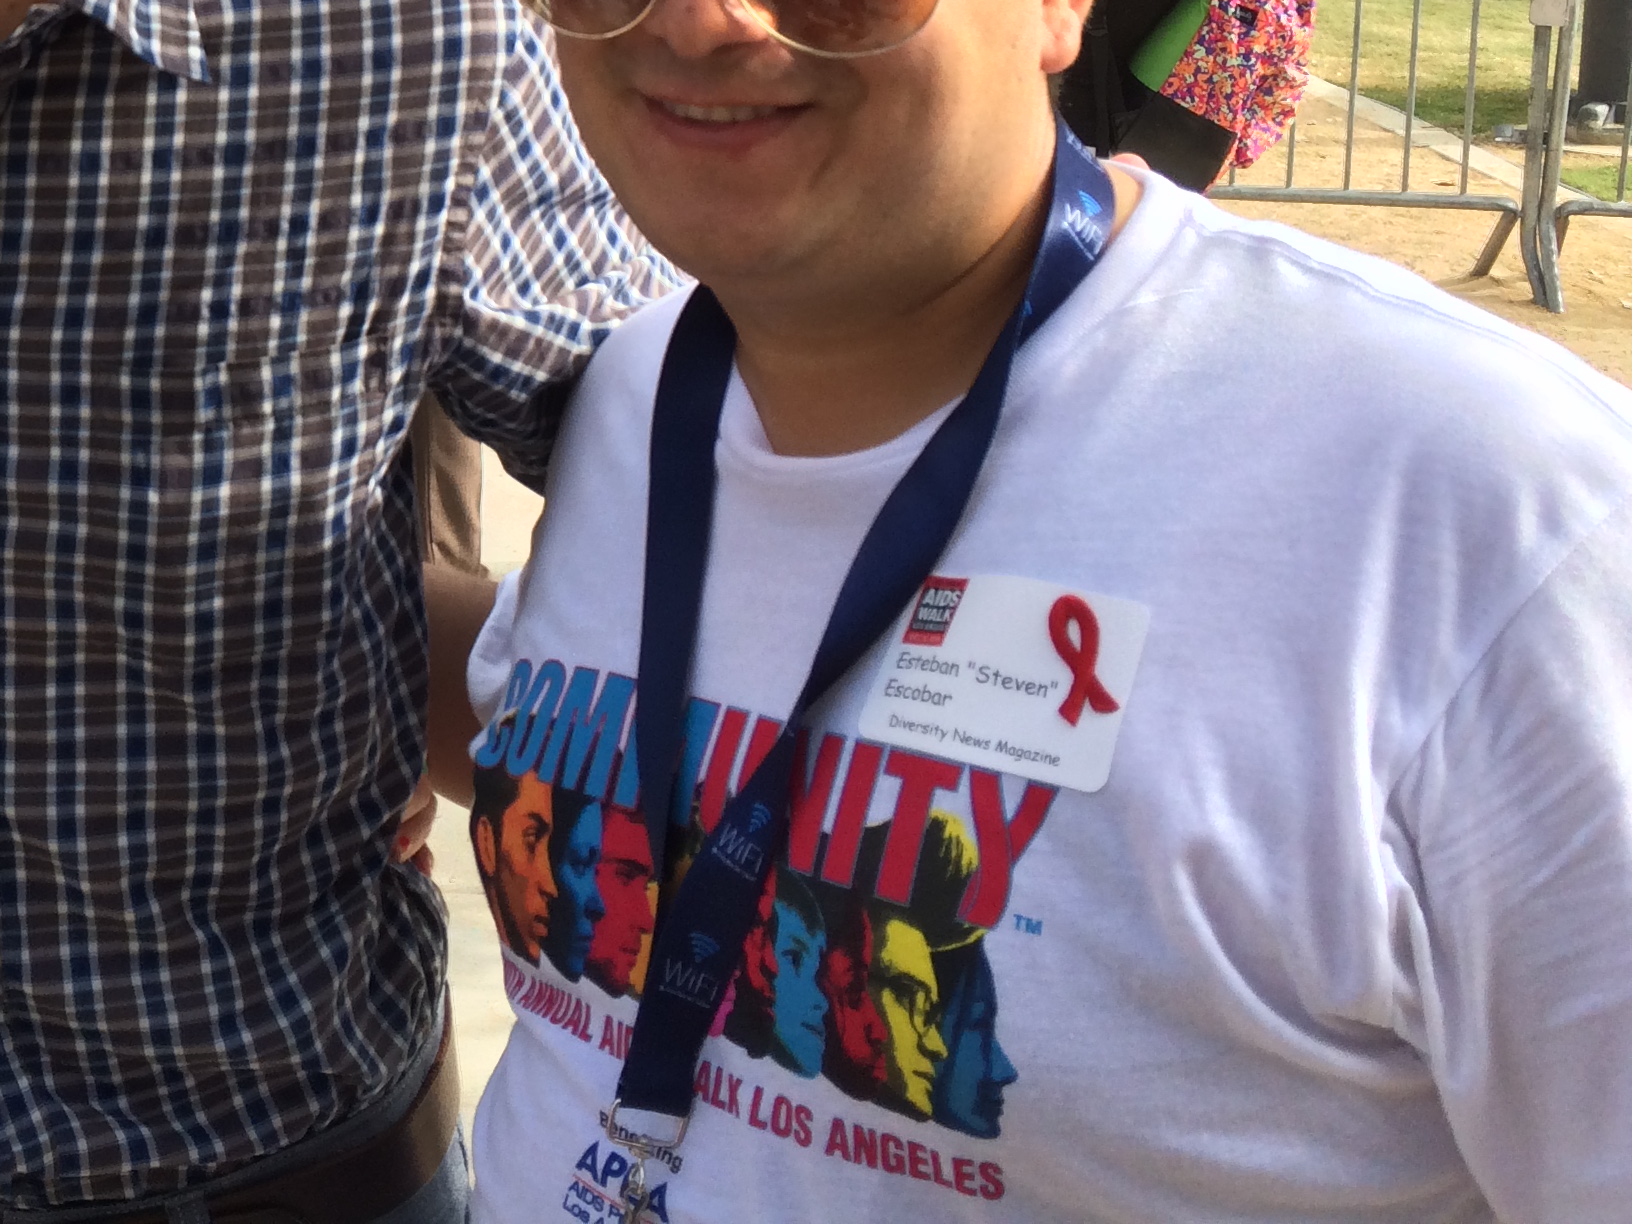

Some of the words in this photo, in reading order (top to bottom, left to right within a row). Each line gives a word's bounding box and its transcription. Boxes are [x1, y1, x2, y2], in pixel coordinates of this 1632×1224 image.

[922, 588, 962, 608] AIDS
[918, 606, 953, 622] WALK
[896, 652, 960, 678] Esteban
[967, 661, 1059, 699] "Steven"
[884, 679, 953, 707] Escobar
[888, 714, 948, 742] Diversity
[952, 727, 991, 751] News
[995, 740, 1061, 767] Magazine
[1013, 913, 1043, 937] TM
[516, 975, 593, 1043] ANNUAL
[693, 1061, 741, 1119] ALK
[748, 1086, 814, 1148] LOS
[825, 1117, 1006, 1201] ANGELES
[568, 1180, 605, 1213] AIDS
